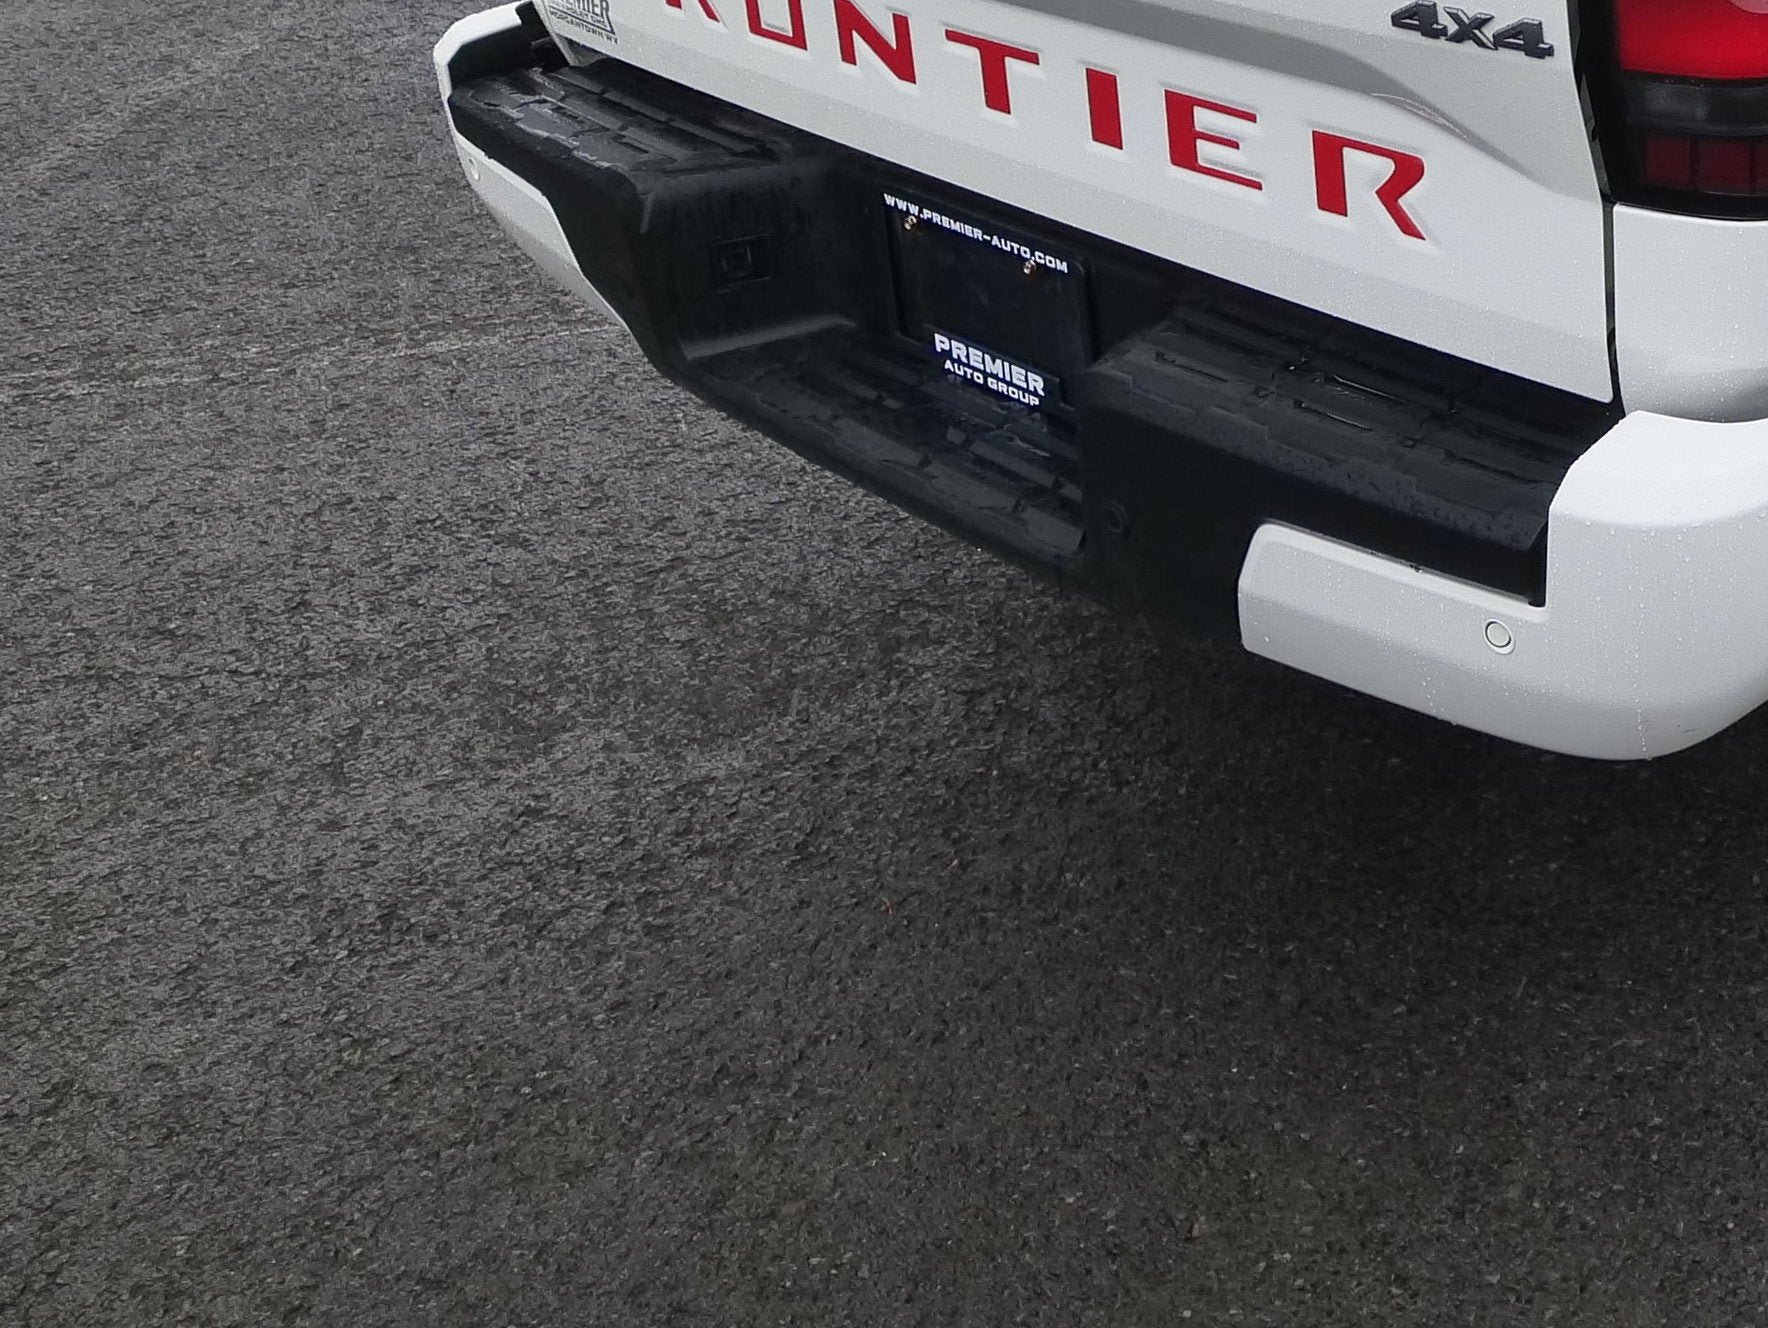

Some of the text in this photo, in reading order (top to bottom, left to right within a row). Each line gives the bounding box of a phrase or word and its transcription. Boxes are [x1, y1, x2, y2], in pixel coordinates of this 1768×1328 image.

[884, 193, 1069, 273] WWW.PREMIER-AUTO.COM
[934, 332, 1045, 397] PREMIER
[944, 359, 1040, 407] AUTO GROUP
